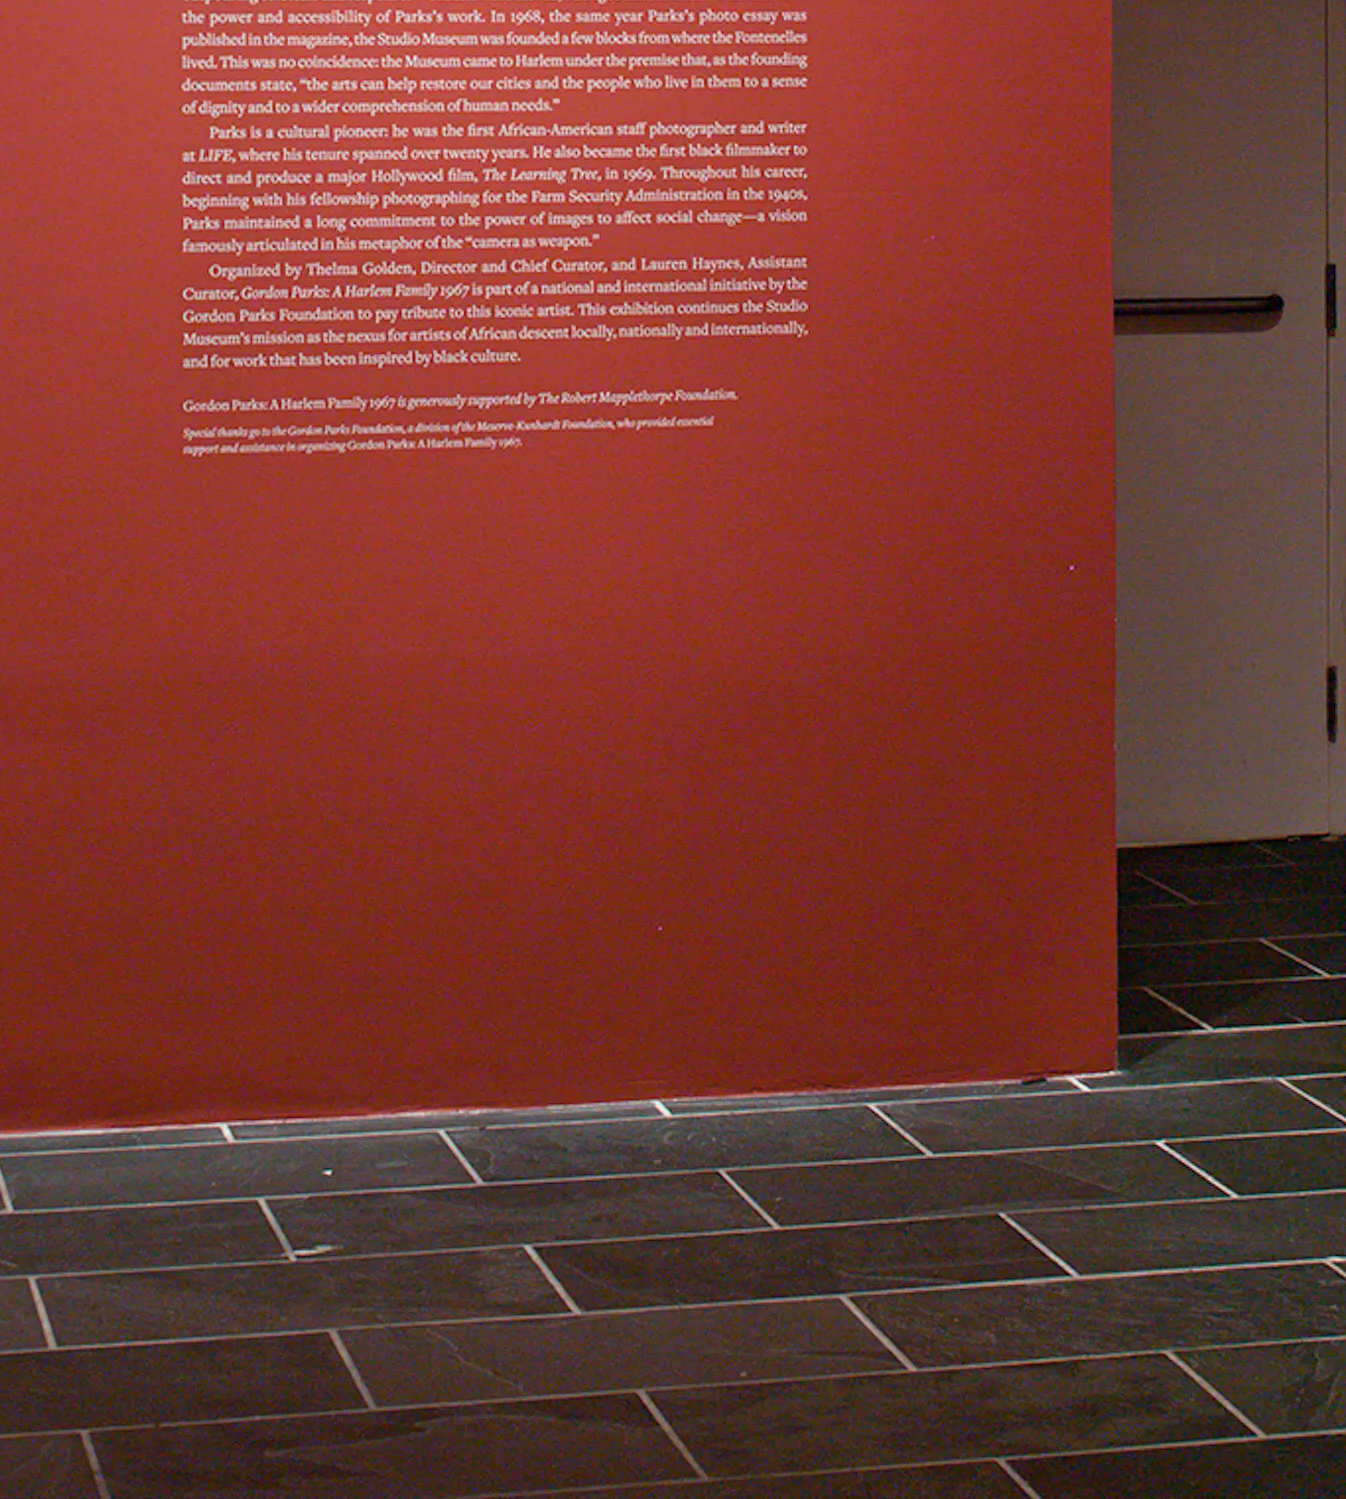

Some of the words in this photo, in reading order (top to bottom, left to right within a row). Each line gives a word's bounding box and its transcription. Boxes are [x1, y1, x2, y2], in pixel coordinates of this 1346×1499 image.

[210, 125, 247, 139] Parks
[250, 126, 262, 138] is
[266, 128, 274, 139] a
[277, 124, 330, 139] cultural
[333, 125, 389, 142] pioneer:
[392, 124, 409, 138] he
[412, 127, 438, 137] was
[442, 124, 464, 137] the
[467, 123, 494, 137] first
[617, 122, 647, 135] staff
[649, 121, 737, 139] photographer
[740, 120, 764, 134] and
[768, 121, 807, 134] writer
[181, 171, 222, 185] direct
[226, 170, 252, 184] and
[256, 170, 312, 188] produce
[315, 173, 324, 183] a
[328, 170, 367, 187] major
[372, 168, 444, 186] Hollywood
[448, 167, 478, 183] film,
[482, 168, 507, 181] The
[510, 167, 567, 184] Learning
[570, 167, 602, 181] Tree,
[605, 167, 619, 180] in
[623, 167, 656, 182] 1969.
[660, 165, 737, 183] Throughout
[741, 165, 761, 178] his
[764, 167, 808, 179] career,
[182, 193, 249, 211] beginning
[252, 193, 283, 206] with
[286, 192, 306, 206] his
[310, 191, 379, 209] fellowship
[382, 190, 480, 209] photographing
[483, 189, 503, 204] for
[506, 190, 528, 203] the
[531, 190, 566, 203] Farm
[569, 189, 623, 206] Security
[625, 188, 724, 202] Administration
[727, 188, 740, 200] in
[743, 187, 765, 200] the
[768, 189, 808, 202] 1940s,
[209, 263, 281, 282] Organized
[285, 262, 302, 280] by
[305, 262, 358, 276] Thelma
[362, 261, 416, 276] Golden,
[421, 261, 478, 274] Director
[481, 259, 507, 273] and
[510, 258, 549, 273] Chief
[551, 259, 608, 273] Curator,
[611, 257, 636, 271] and
[641, 258, 688, 271] Lauren
[692, 257, 744, 274] Haynes,
[747, 255, 807, 269] Assistant
